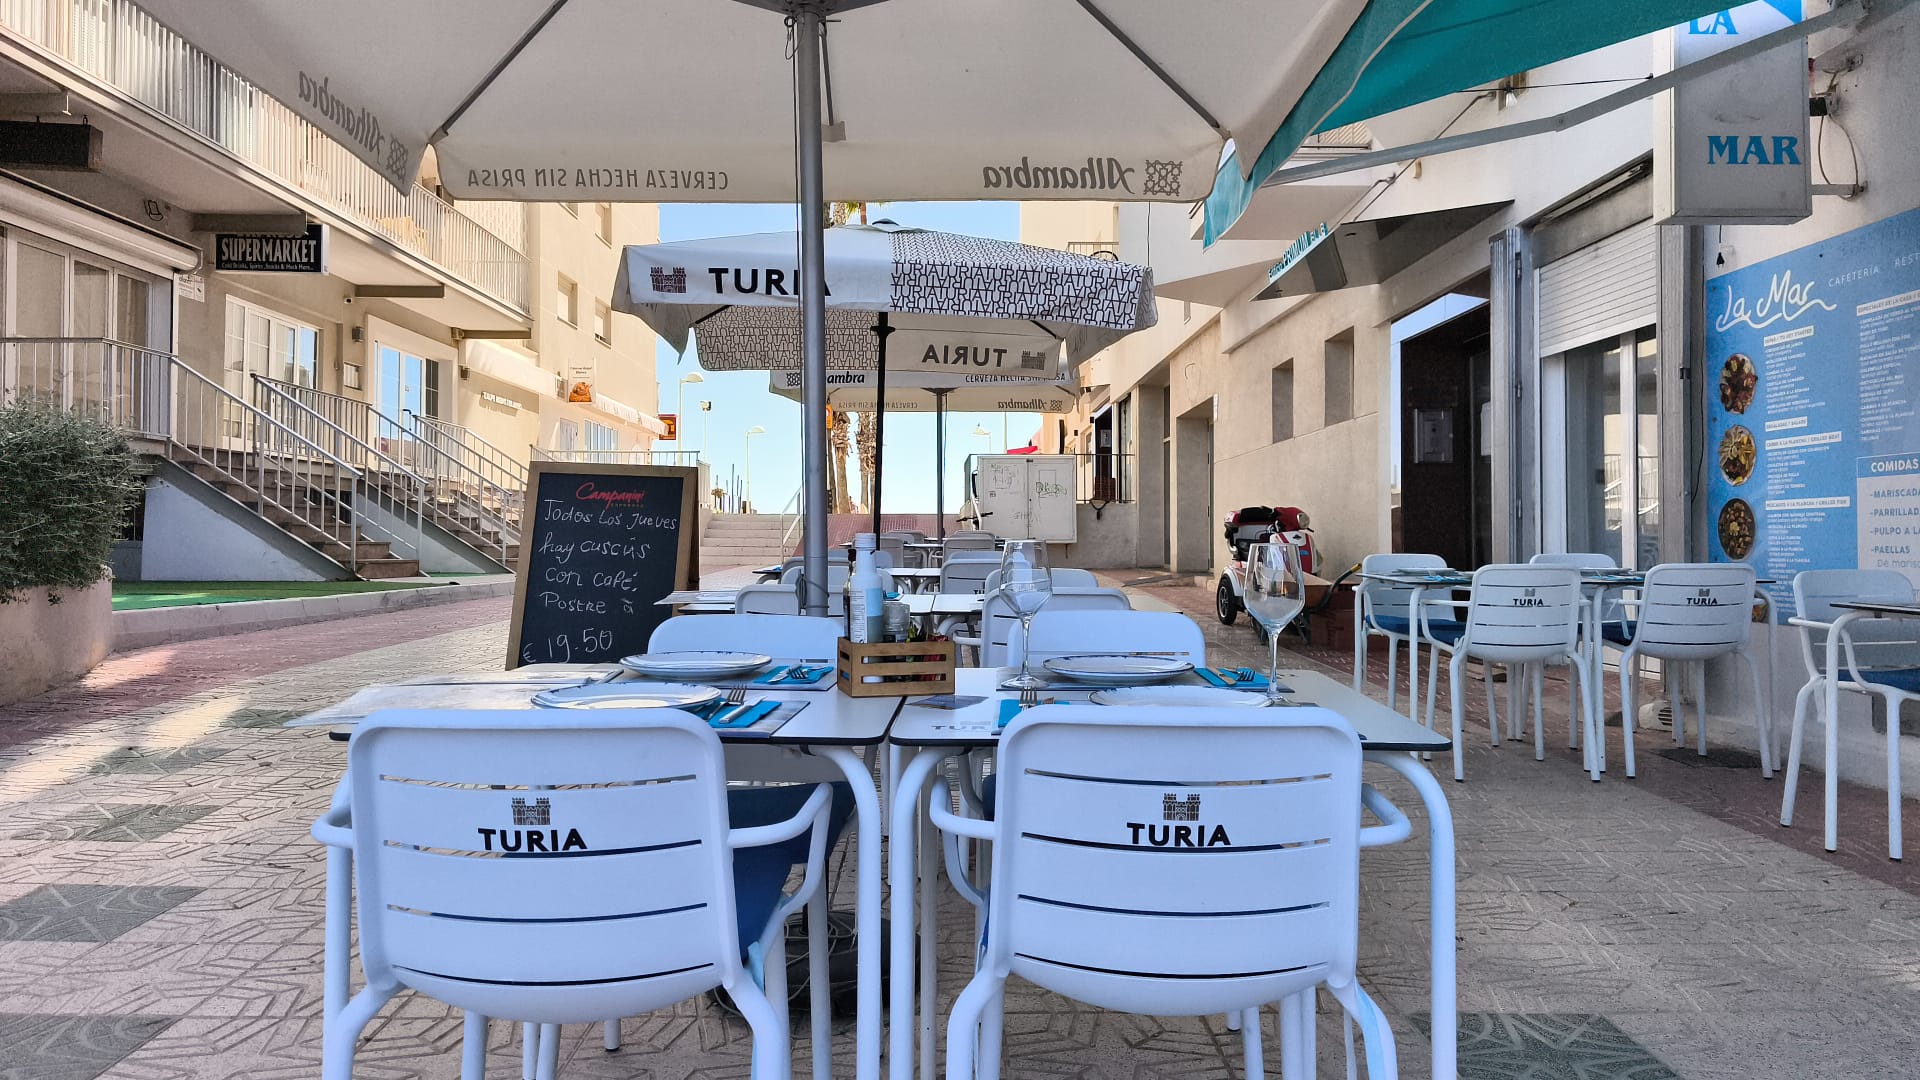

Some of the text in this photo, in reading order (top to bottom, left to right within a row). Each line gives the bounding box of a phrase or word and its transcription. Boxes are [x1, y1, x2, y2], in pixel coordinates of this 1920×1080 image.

[1688, 9, 1739, 35] LA
[1707, 135, 1802, 165] MAR
[222, 237, 316, 262] SUPERMARKET
[708, 267, 831, 297] TURI
[1870, 458, 1919, 473] COMIDAS
[544, 499, 593, 523] Todos
[1870, 507, 1920, 517] -PARRILLAD
[1904, 527, 1911, 535] A
[538, 532, 575, 564] hay
[1512, 598, 1544, 607] TURIA
[1686, 597, 1718, 606] TURIA
[478, 827, 588, 852] TURIA
[1126, 822, 1232, 847] TURIA
